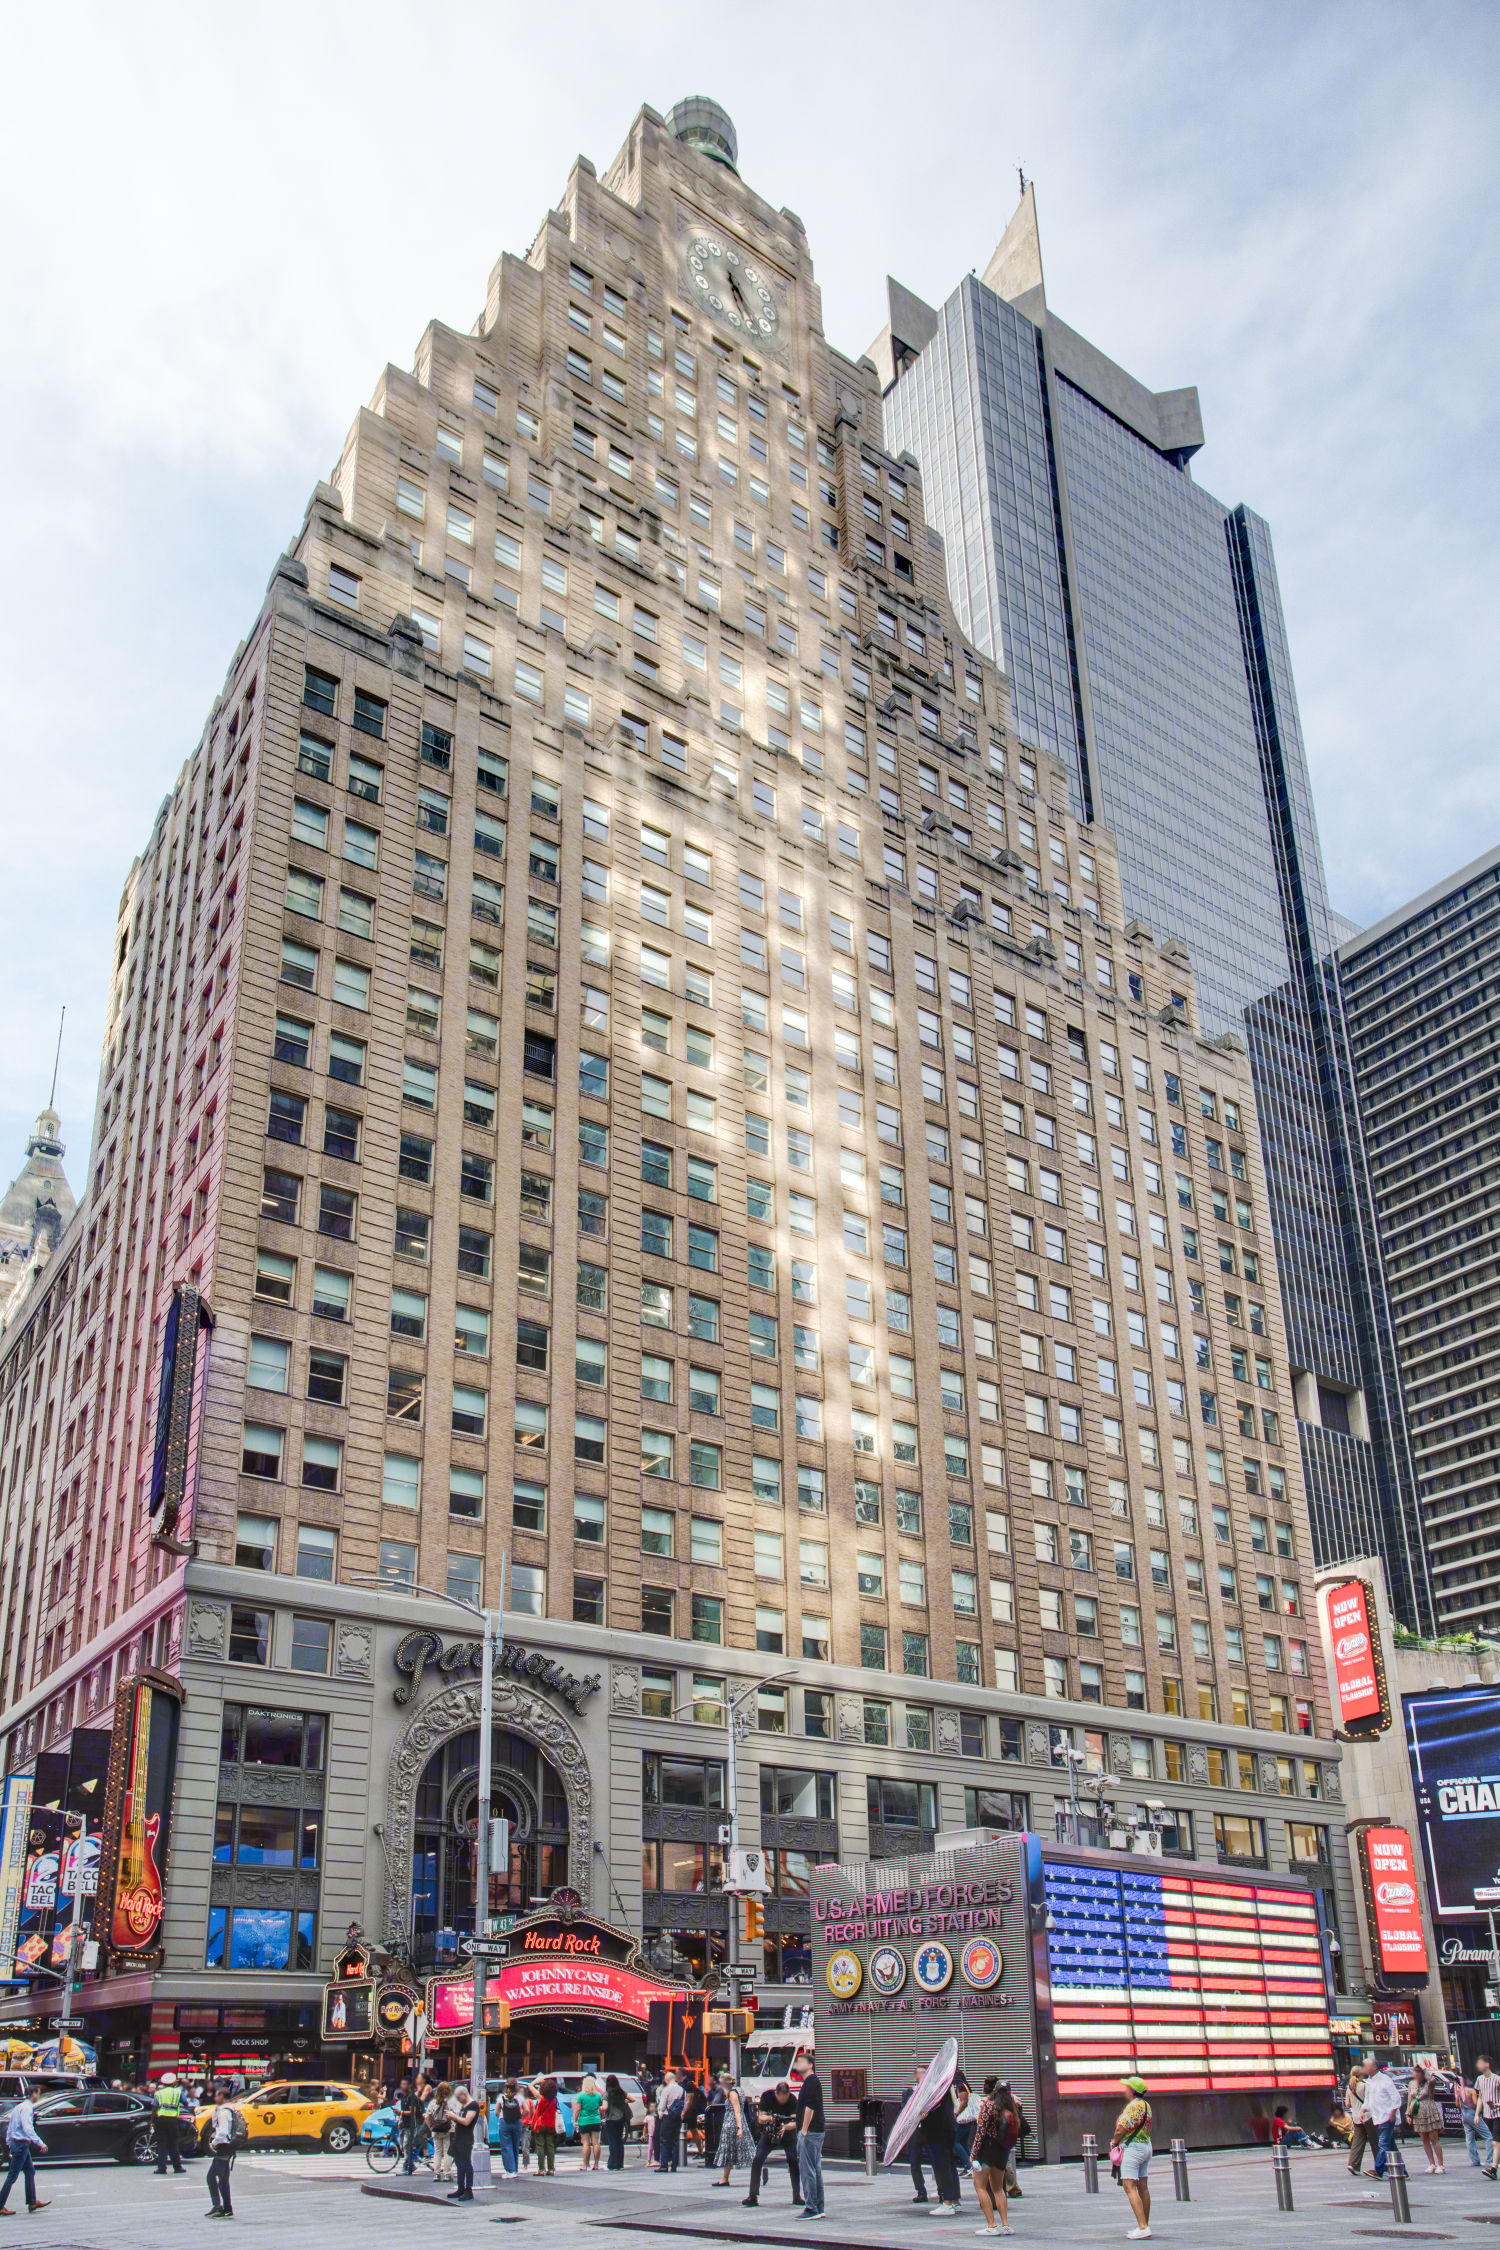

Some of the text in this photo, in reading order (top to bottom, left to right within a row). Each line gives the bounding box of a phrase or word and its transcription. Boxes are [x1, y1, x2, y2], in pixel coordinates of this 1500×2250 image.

[1333, 1597, 1359, 1615] NOW
[1333, 1610, 1362, 1629] OPEN
[1340, 1675, 1373, 1693] GLOBAL
[248, 1709, 303, 1720] DAKTRONICS
[1437, 1776, 1480, 1787] OFFICIAL
[1373, 1843, 1404, 1857] NOW
[1373, 1858, 1409, 1872] OPEN
[30, 1885, 56, 1895] TAC
[30, 1895, 54, 1905] BEL
[119, 1892, 166, 1921] Hard Rock
[814, 1879, 1013, 1921] U.S. ARMED FORCES
[492, 1920, 498, 1932] W
[500, 1919, 507, 1931] 43
[824, 1909, 1002, 1943] RECRUITING STATION
[1381, 1930, 1421, 1941] GLOBAL
[466, 1942, 504, 1953] ONE WAY
[524, 1931, 601, 1955] Hard Rock
[488, 1965, 498, 1974] WAY
[521, 1967, 610, 1985] JOHNNY CASH
[505, 1985, 535, 2001] WAX
[535, 1983, 582, 1998] FIGURE
[582, 1984, 624, 2004] INSIDE
[827, 2003, 852, 2014] ARMY
[859, 2000, 888, 2012] NAVY
[919, 1996, 950, 2009] FORC
[961, 1993, 1007, 2008] MARINES
[231, 2038, 269, 2046] ROCK SHOP
[1375, 2034, 1411, 2042] QURE
